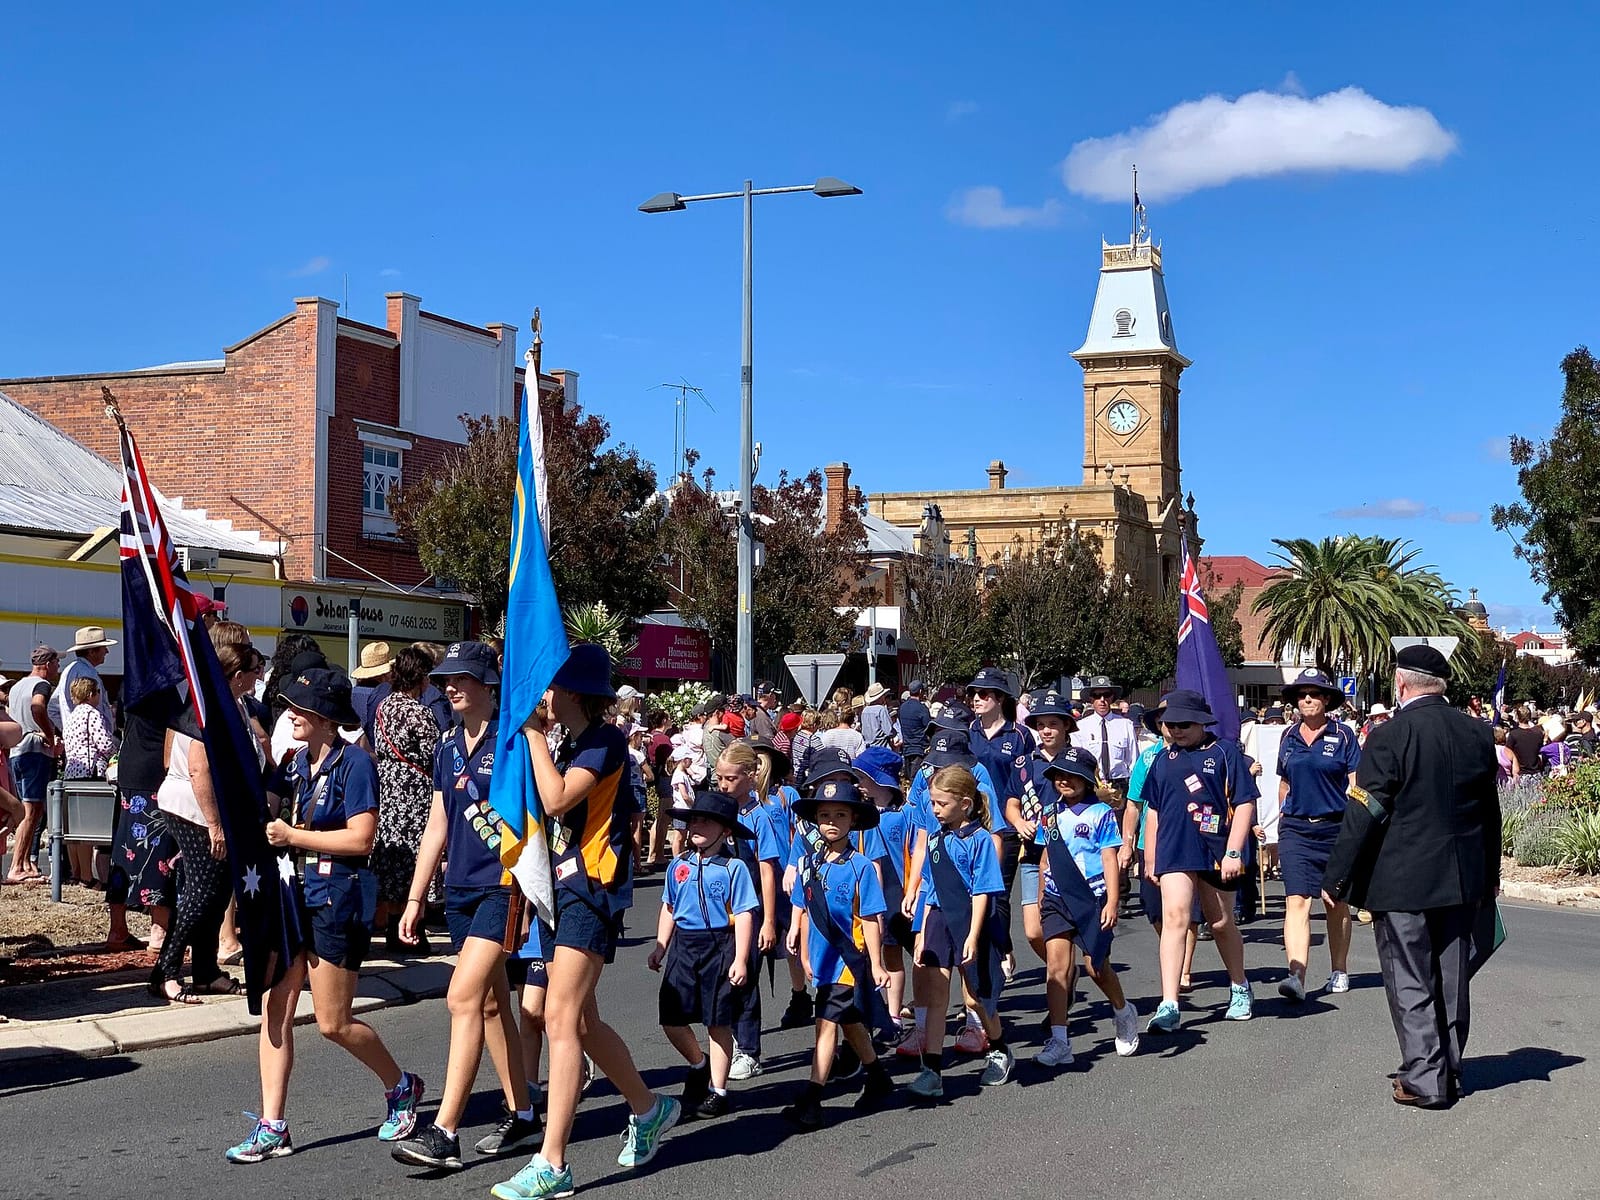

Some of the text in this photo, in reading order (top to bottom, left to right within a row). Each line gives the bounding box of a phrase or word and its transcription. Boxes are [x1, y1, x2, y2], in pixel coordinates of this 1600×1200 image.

[316, 595, 384, 622] Soban ouse
[389, 615, 437, 630] 07 4661 2652
[674, 634, 698, 648] Jewellery
[668, 646, 699, 658] Homewares
[655, 658, 666, 669] Soft
[667, 658, 699, 672] Furnishings
